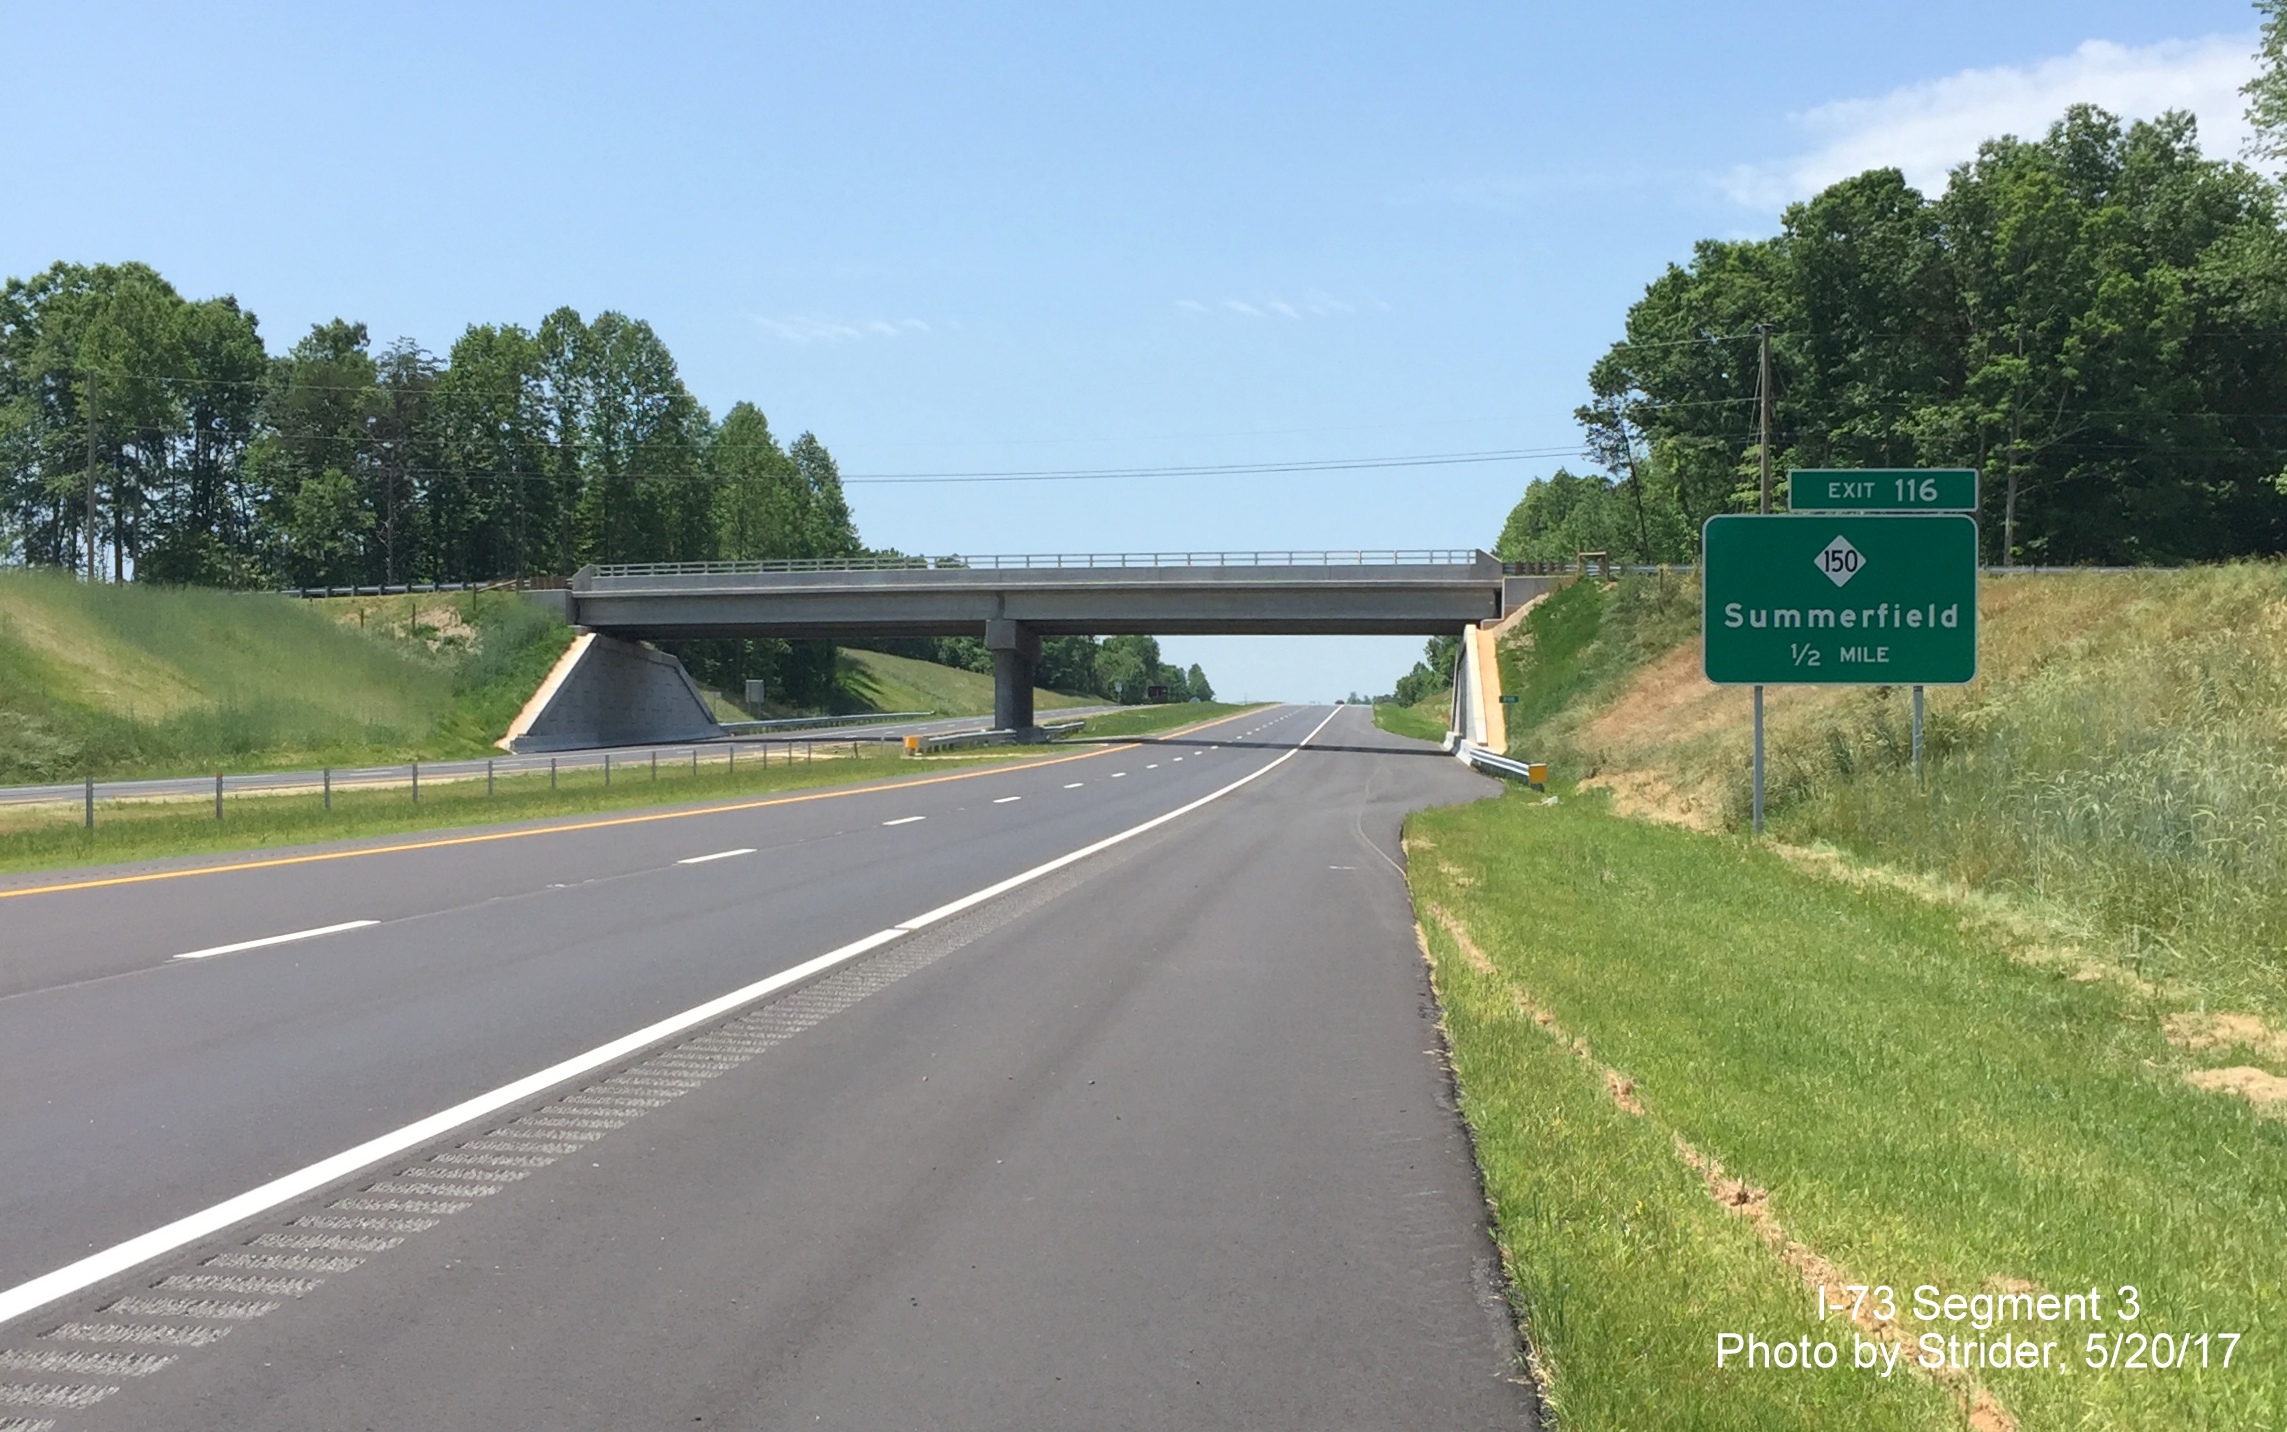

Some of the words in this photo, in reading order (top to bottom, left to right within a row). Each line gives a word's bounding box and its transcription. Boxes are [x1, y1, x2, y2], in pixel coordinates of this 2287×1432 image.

[1828, 482, 1875, 498] EXIT
[1895, 478, 1938, 502] 116
[1824, 550, 1858, 573] 150
[1724, 603, 1958, 628] Summerfield
[1840, 646, 1889, 663] MILE
